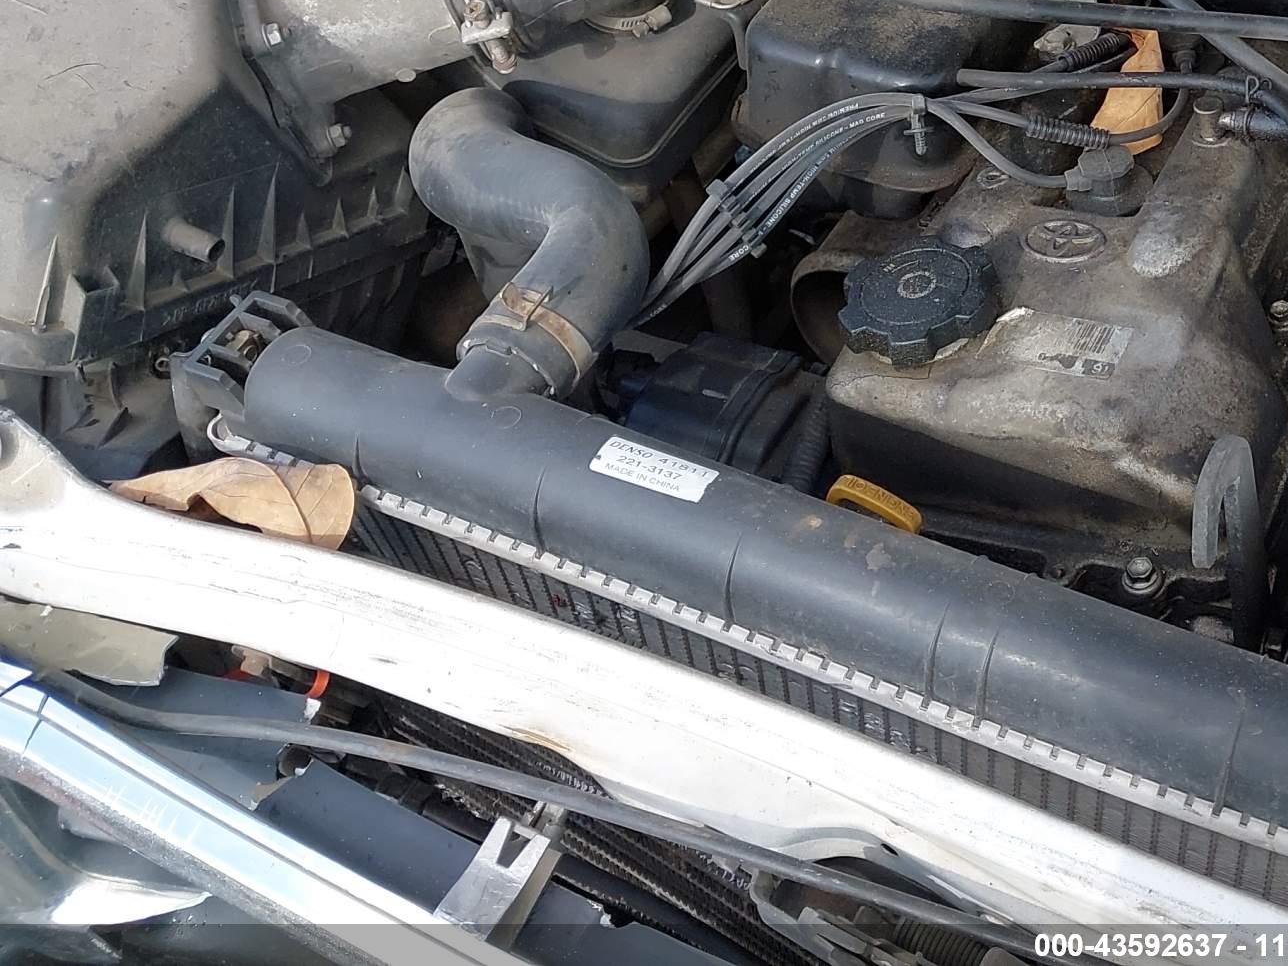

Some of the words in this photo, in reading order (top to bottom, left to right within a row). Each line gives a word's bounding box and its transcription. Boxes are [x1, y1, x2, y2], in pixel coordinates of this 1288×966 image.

[728, 244, 750, 262] CORE
[609, 440, 654, 459] DENSO
[604, 462, 634, 477] MADE
[636, 472, 648, 482] IN
[649, 477, 681, 492] CHINA
[615, 455, 683, 480] 221-3137
